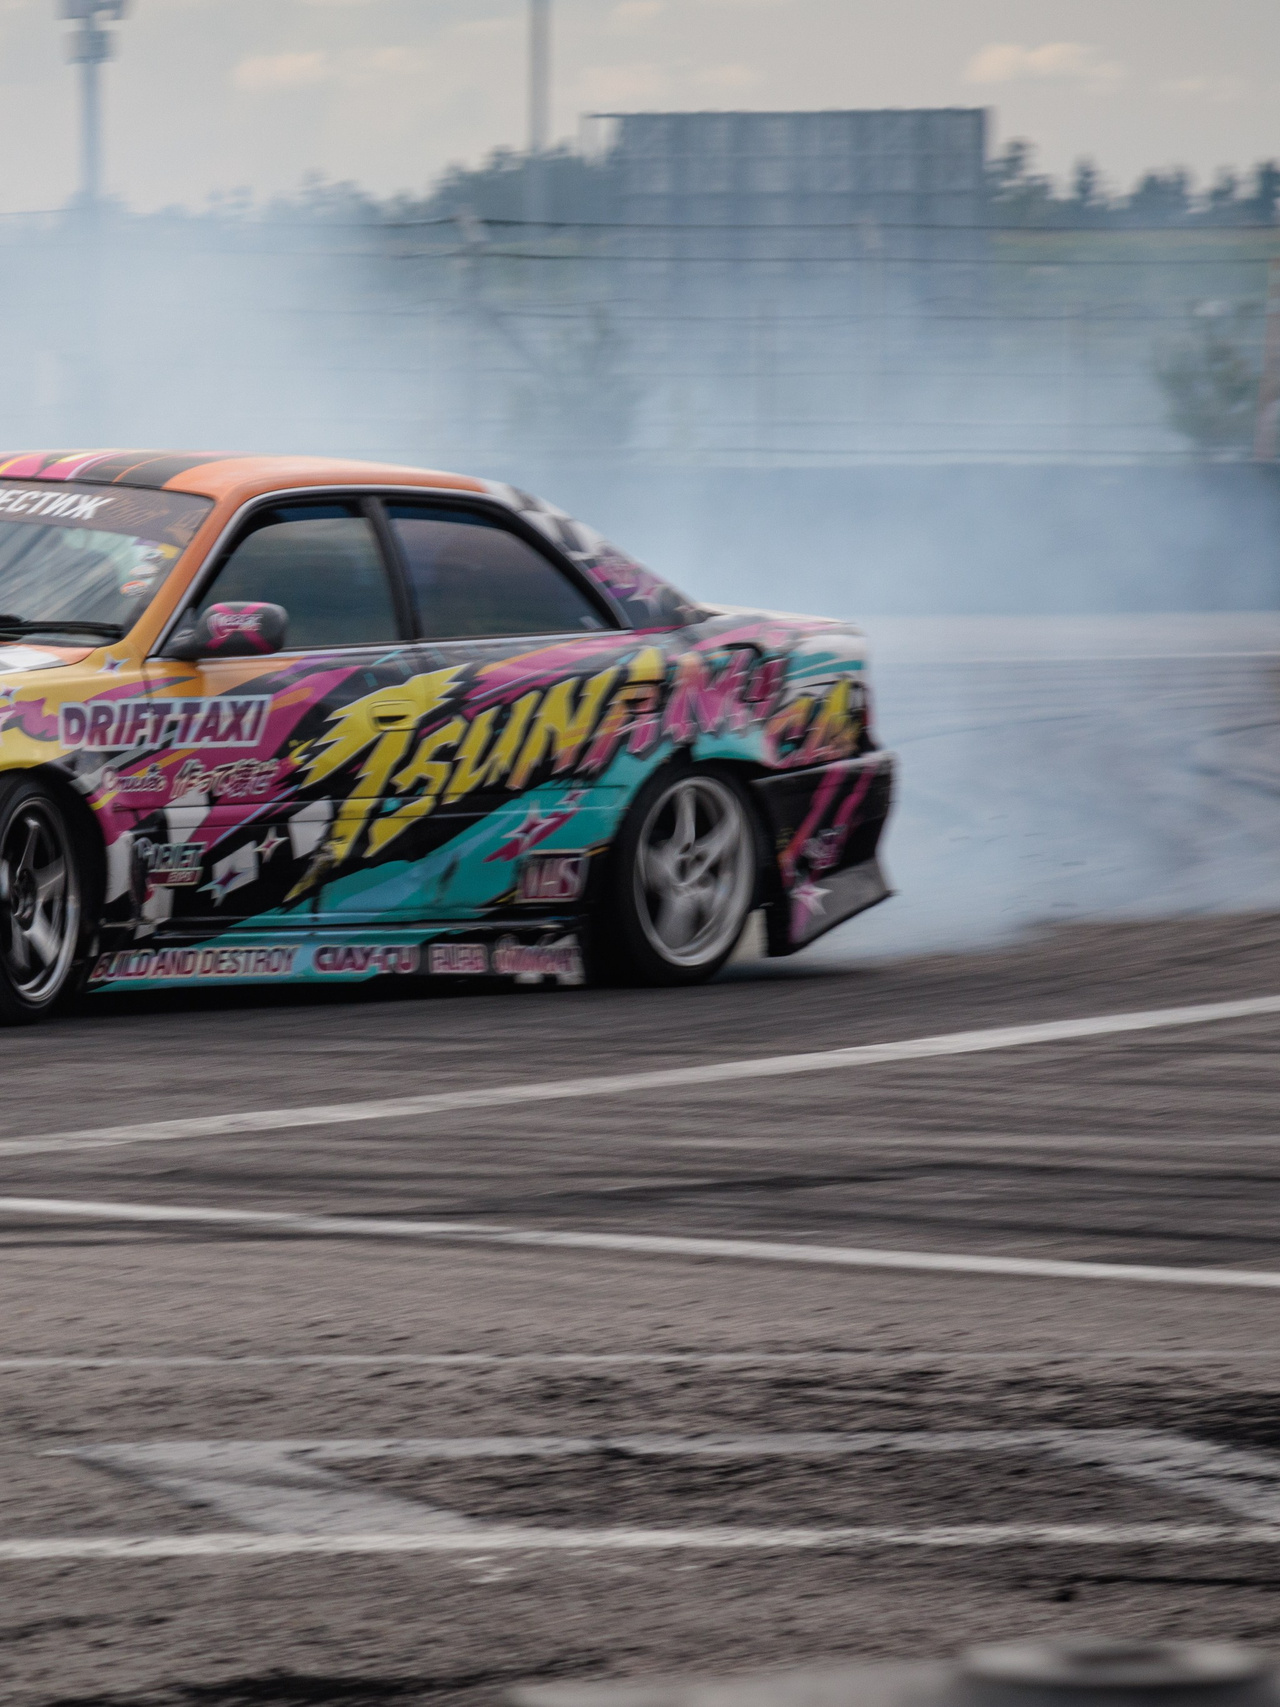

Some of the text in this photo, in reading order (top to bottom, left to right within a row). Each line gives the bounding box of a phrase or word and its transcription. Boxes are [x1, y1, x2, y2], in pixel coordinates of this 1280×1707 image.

[62, 700, 272, 747] DRIFT TAXI
[90, 946, 300, 979] BUILD AND DESTROY
